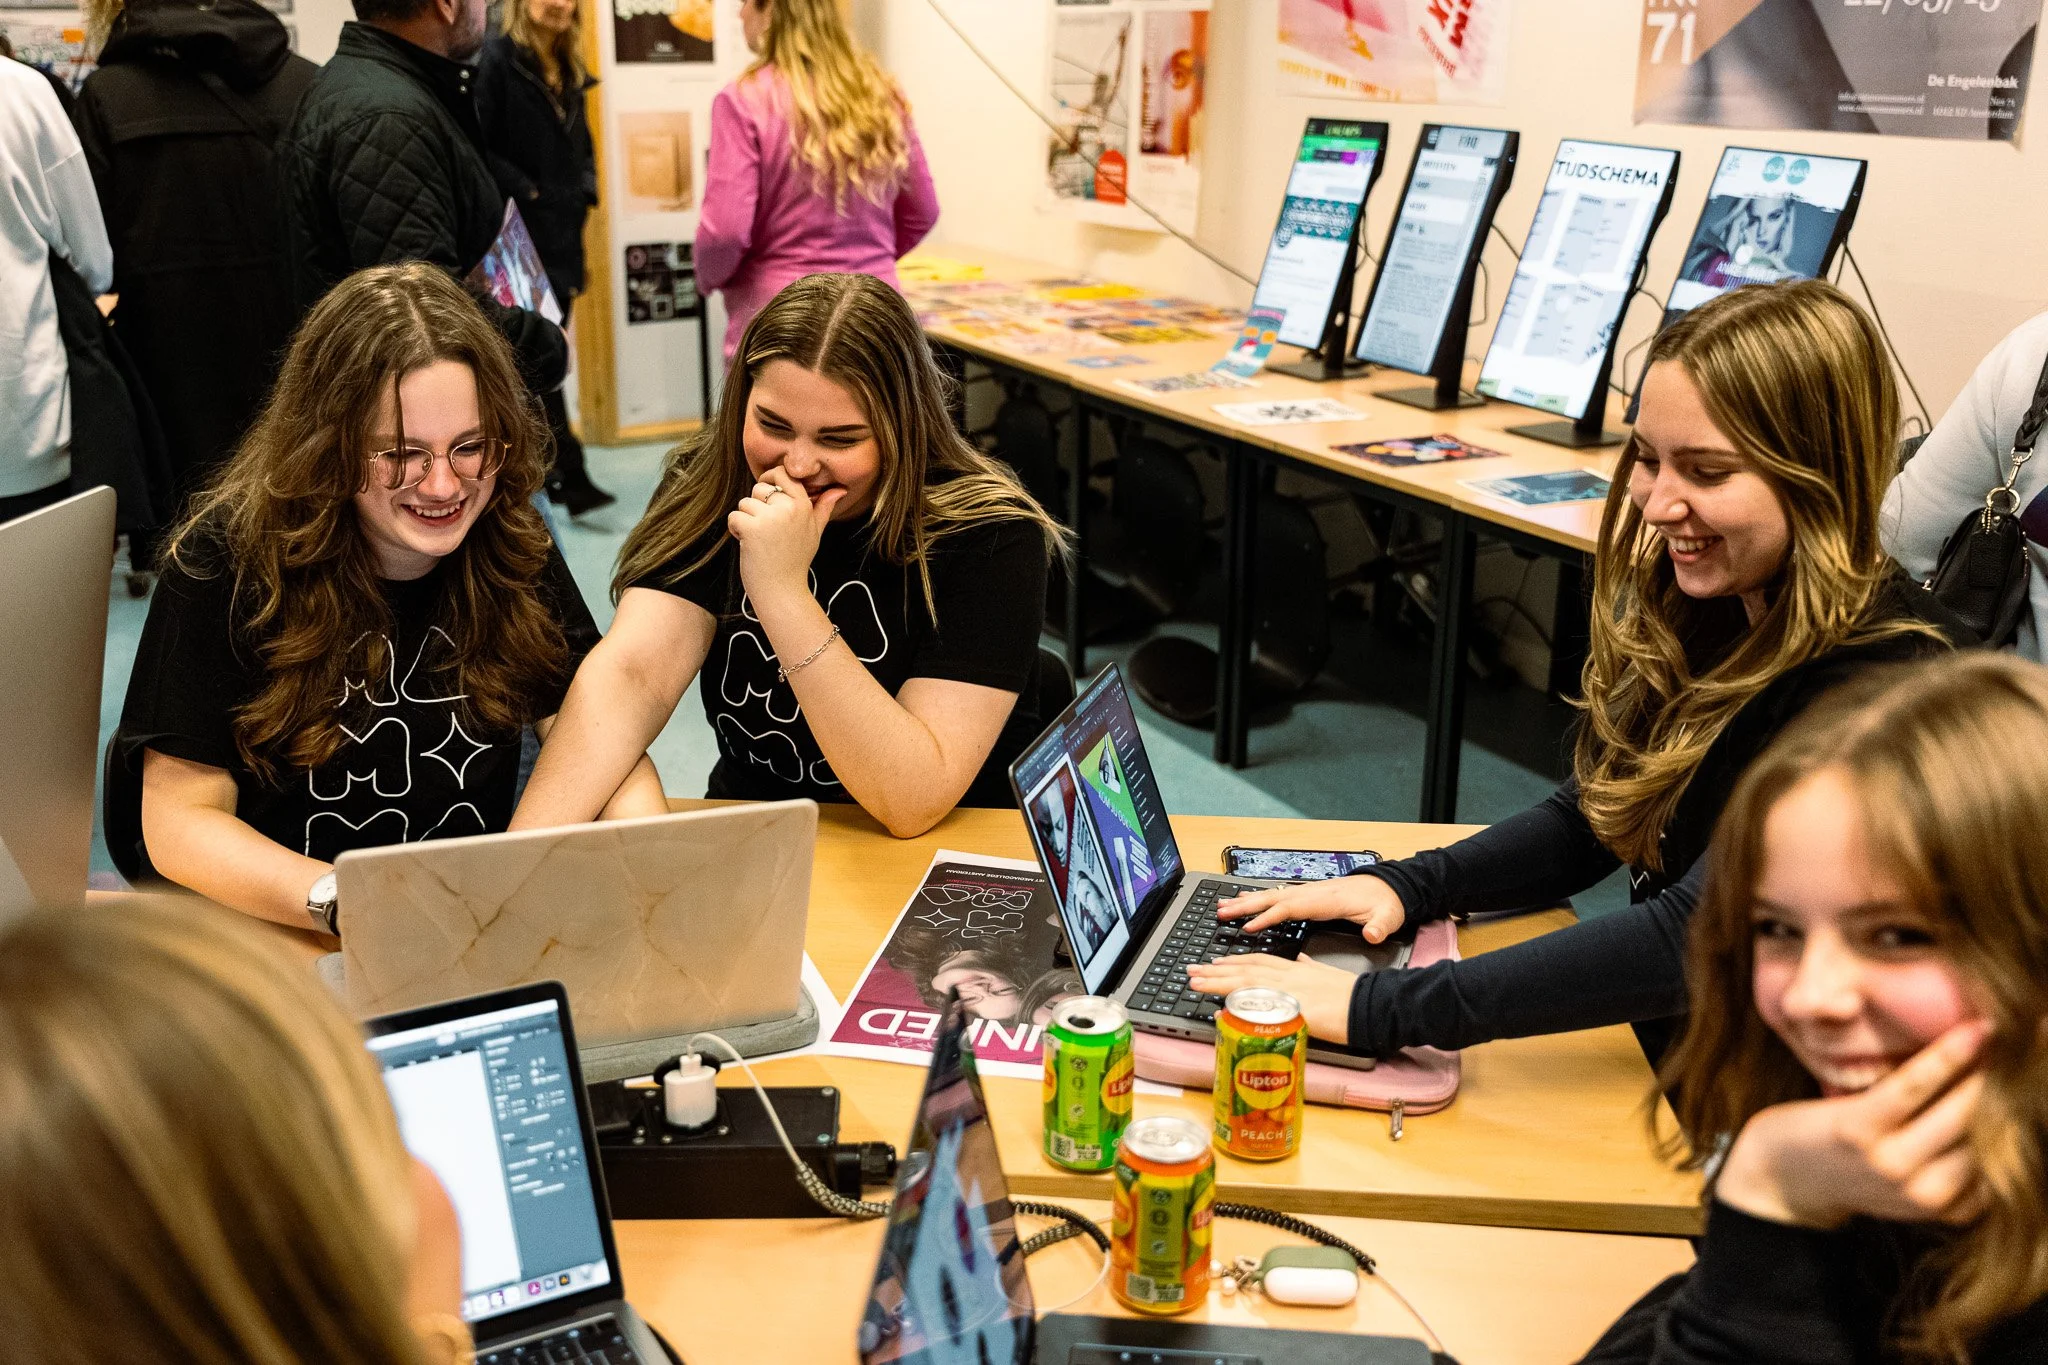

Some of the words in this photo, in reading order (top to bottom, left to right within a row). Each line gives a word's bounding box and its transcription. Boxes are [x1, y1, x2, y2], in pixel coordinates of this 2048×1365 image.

[1647, 12, 1696, 65] 71
[1927, 73, 1945, 87] De
[1947, 73, 2018, 90] Engelenbak
[946, 868, 986, 877] AMSTERDAM
[987, 872, 1035, 882] MEDIACOLLEGE
[1254, 1025, 1281, 1034] PEACH
[1241, 1072, 1288, 1089] Lipton
[1240, 1128, 1284, 1141] PEACH
